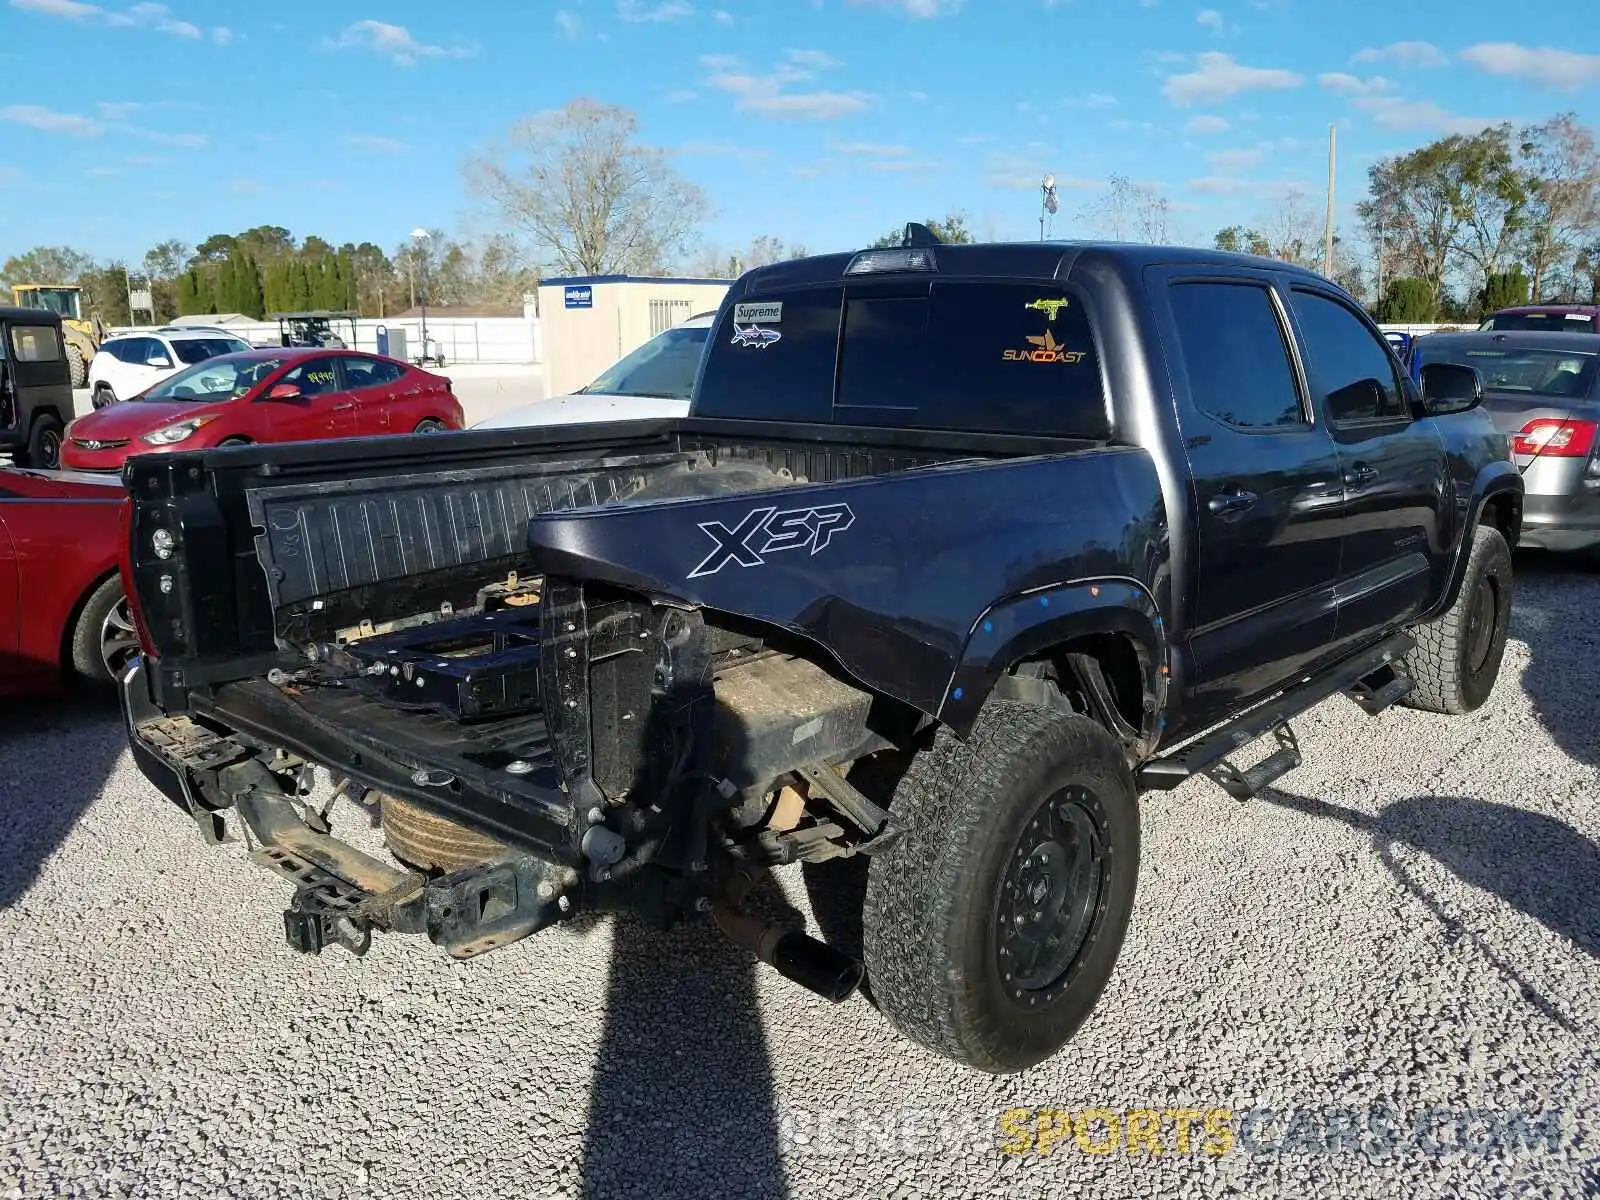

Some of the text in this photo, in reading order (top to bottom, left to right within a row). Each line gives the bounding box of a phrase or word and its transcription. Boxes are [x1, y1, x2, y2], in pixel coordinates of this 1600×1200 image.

[737, 305, 779, 320] Supreme
[1002, 349, 1086, 364] SUNCOAST
[686, 502, 856, 579] XSP
